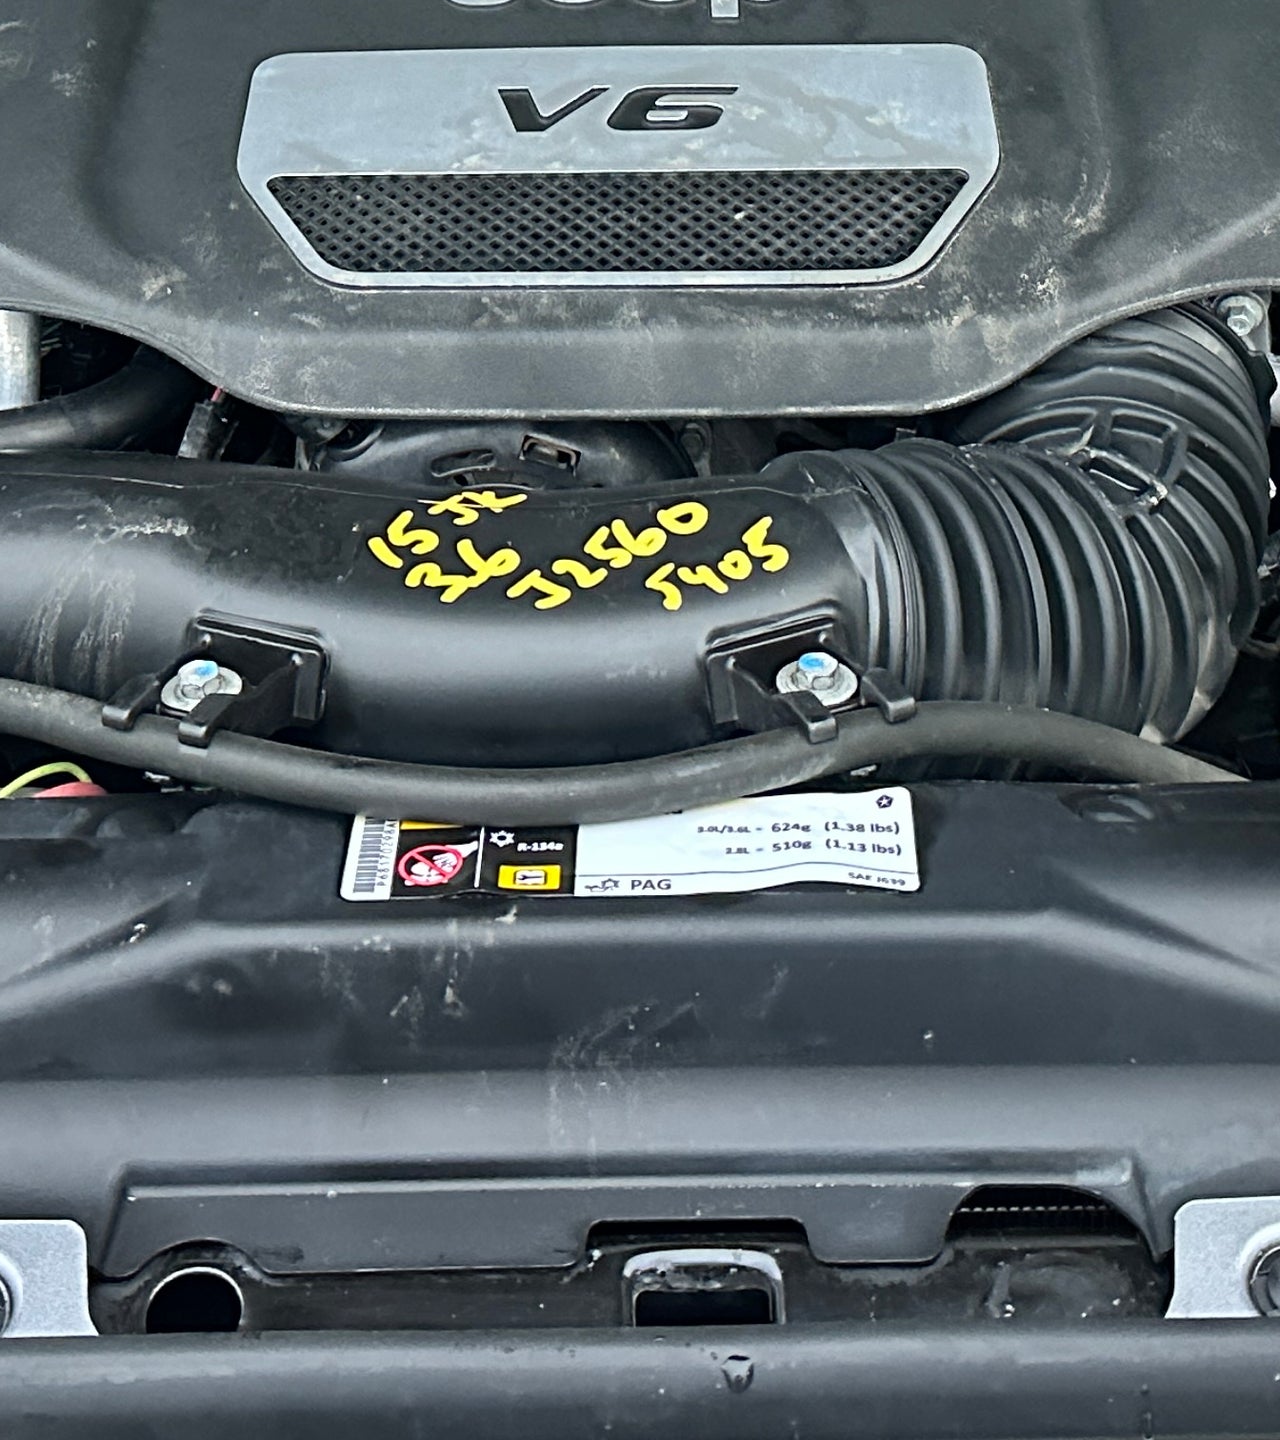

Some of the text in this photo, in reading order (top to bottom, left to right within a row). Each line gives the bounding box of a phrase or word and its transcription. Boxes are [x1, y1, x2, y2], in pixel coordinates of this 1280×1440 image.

[497, 84, 739, 133] V6
[771, 823, 812, 833] 624g
[824, 821, 866, 833] (1.38
[870, 822, 900, 835] lbs)
[772, 840, 812, 852] 510g
[825, 838, 867, 853] (1.13
[872, 843, 902, 856] lbs)
[630, 879, 672, 891] PAG
